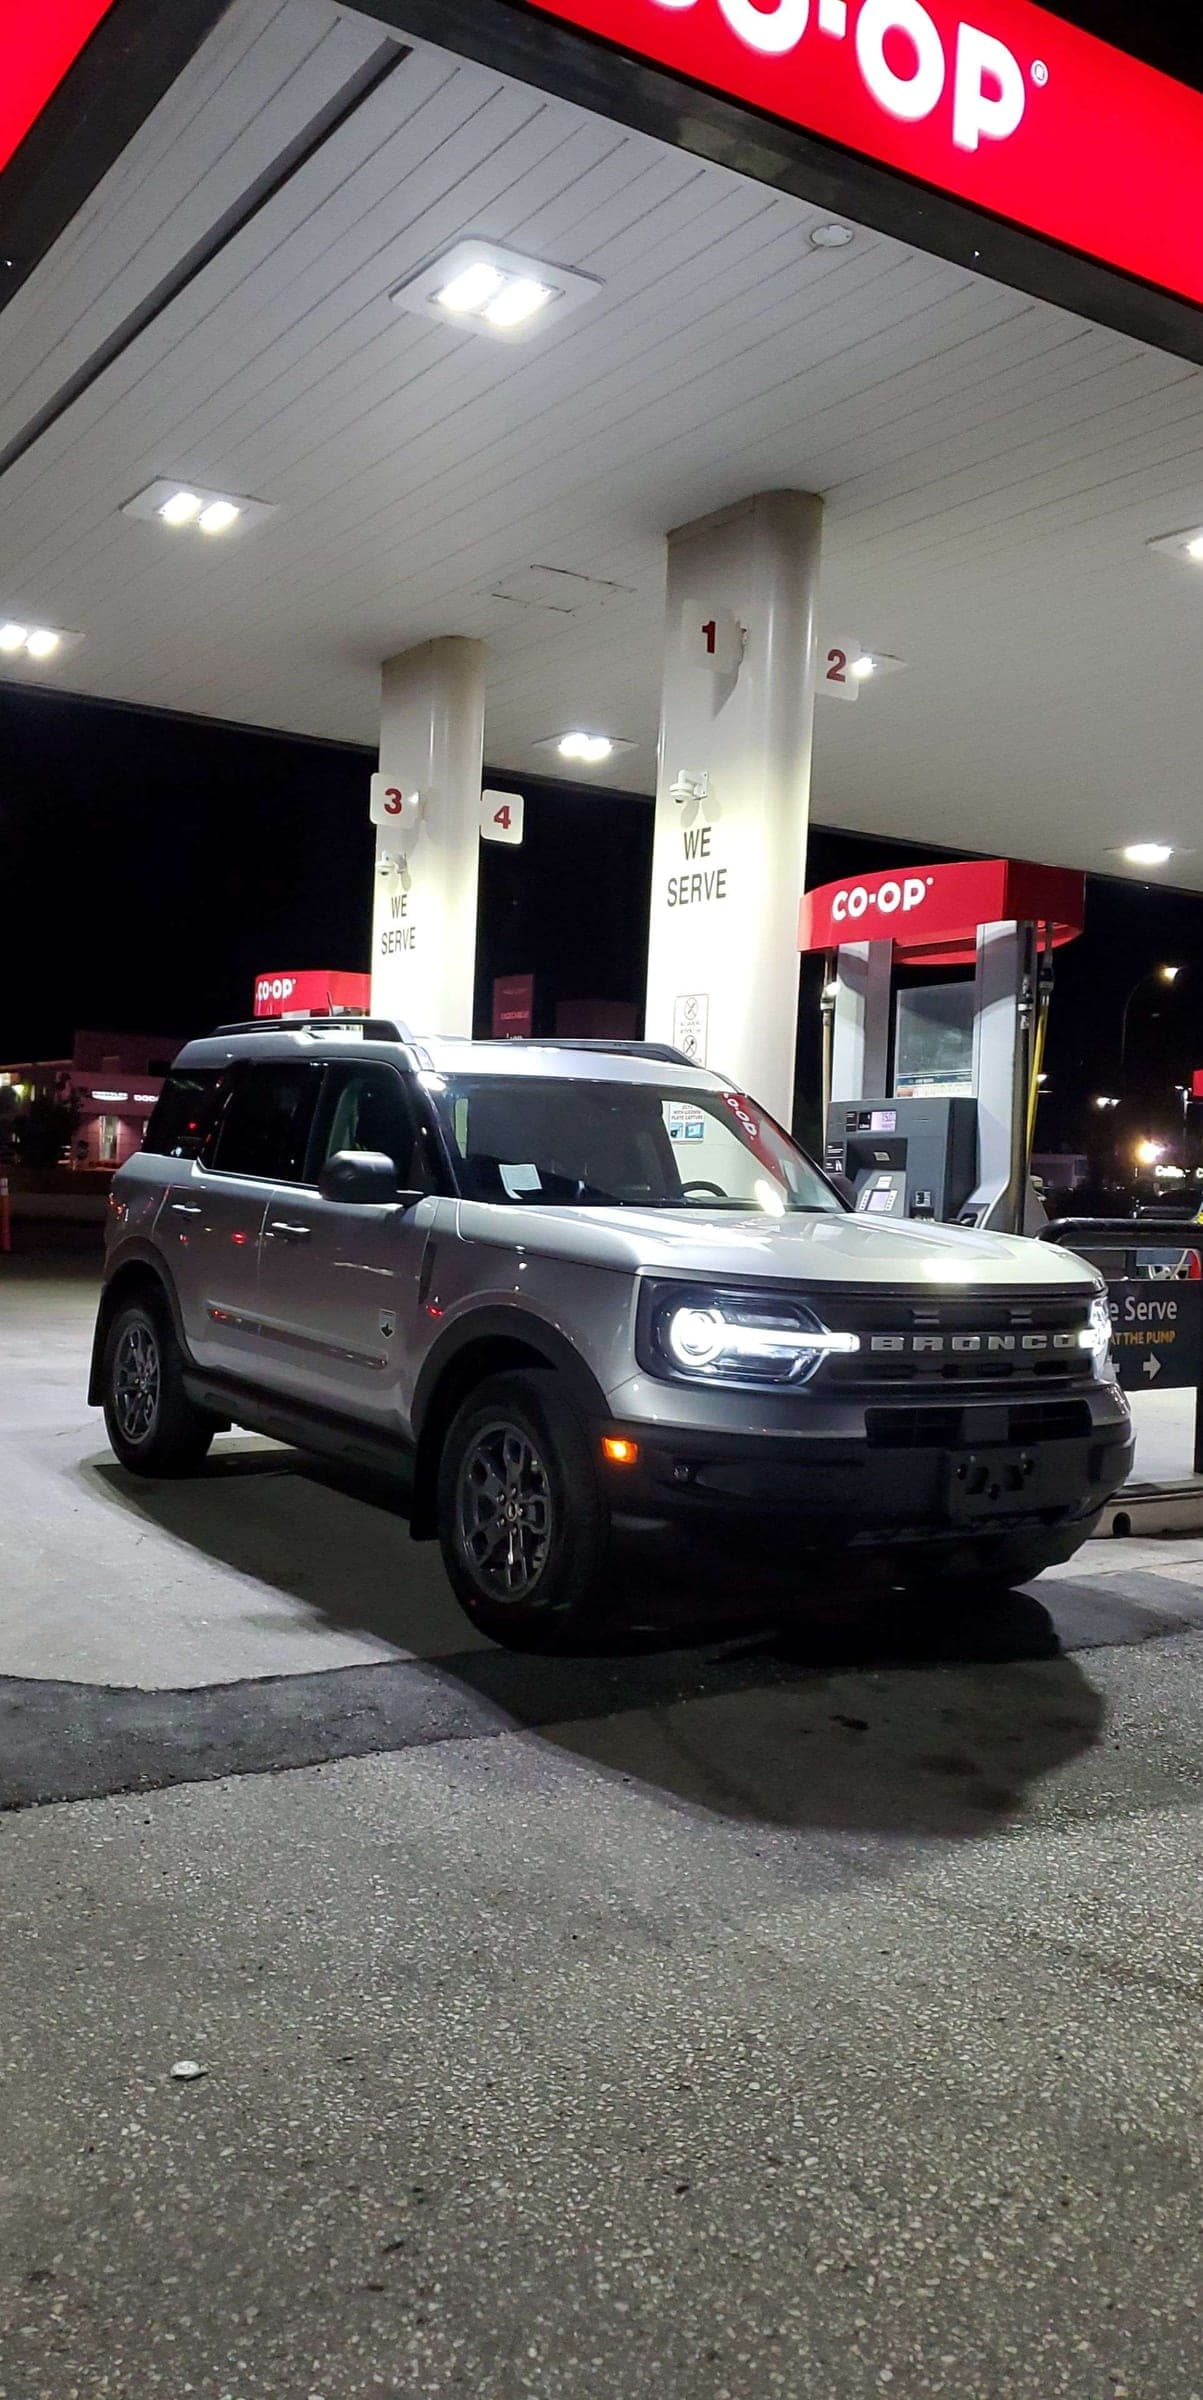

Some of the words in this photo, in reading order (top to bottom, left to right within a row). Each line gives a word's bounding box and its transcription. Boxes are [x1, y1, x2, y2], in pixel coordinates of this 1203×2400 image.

[646, 0, 1026, 152] -OP
[702, 621, 716, 653] 1
[826, 649, 847, 683] 2
[384, 788, 403, 815] 3
[493, 806, 511, 829] 4
[683, 826, 713, 860] WE
[667, 868, 728, 907] SERVE
[832, 877, 926, 920] CO-OP
[390, 893, 408, 919] WE
[381, 926, 416, 955] SERVE
[1109, 1302, 1119, 1321] e
[1124, 1296, 1178, 1321] Serve
[871, 1335, 1076, 1351] BRONCO
[1123, 1331, 1144, 1345] THE
[1146, 1330, 1176, 1344] PUMP
